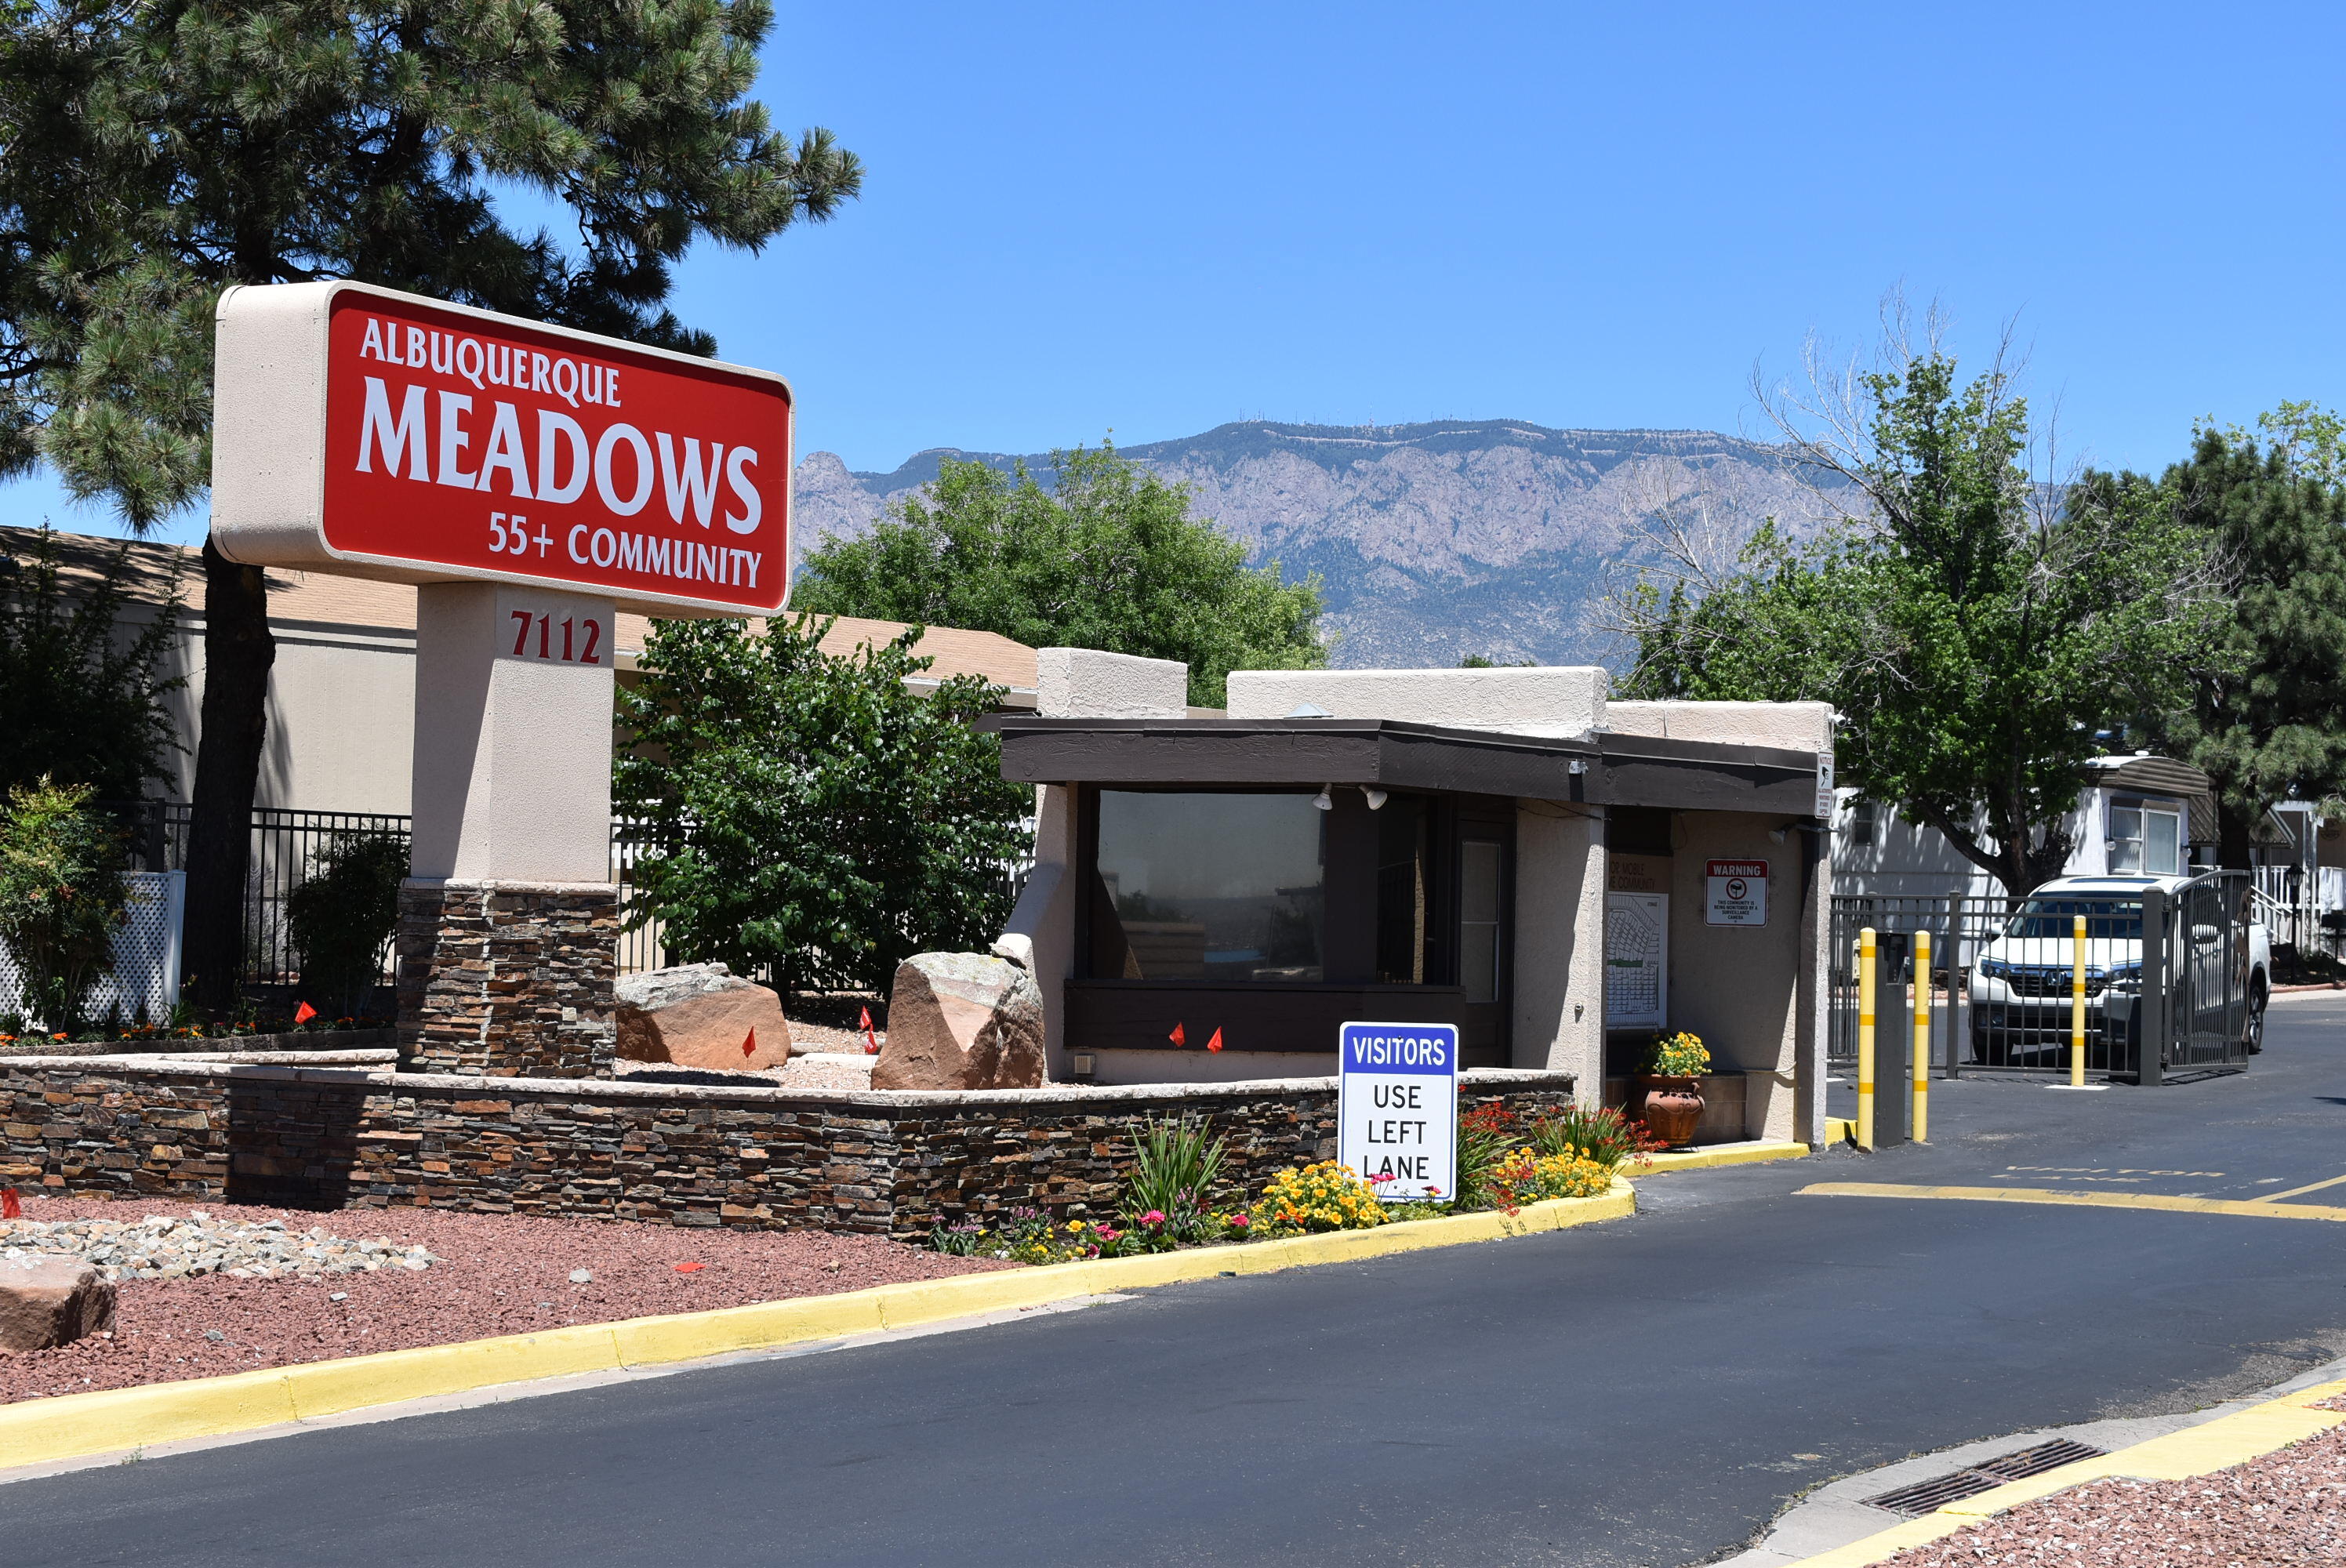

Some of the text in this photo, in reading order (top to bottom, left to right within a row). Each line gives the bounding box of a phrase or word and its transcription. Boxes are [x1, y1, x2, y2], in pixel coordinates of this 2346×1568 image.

[360, 318, 622, 408] ALBUQUERQUE
[356, 376, 762, 535] MEADOWS
[488, 511, 762, 588] 55+ COMMUNITY
[511, 609, 601, 664] 7112
[1819, 757, 1832, 765] NOTICE
[1713, 865, 1761, 877] WARNING
[1618, 877, 1656, 891] COMMUNITY
[1353, 1037, 1446, 1065] VISITORS
[1374, 1084, 1422, 1109] USE
[1368, 1120, 1427, 1145] LEFT
[1364, 1155, 1429, 1180] LANE
